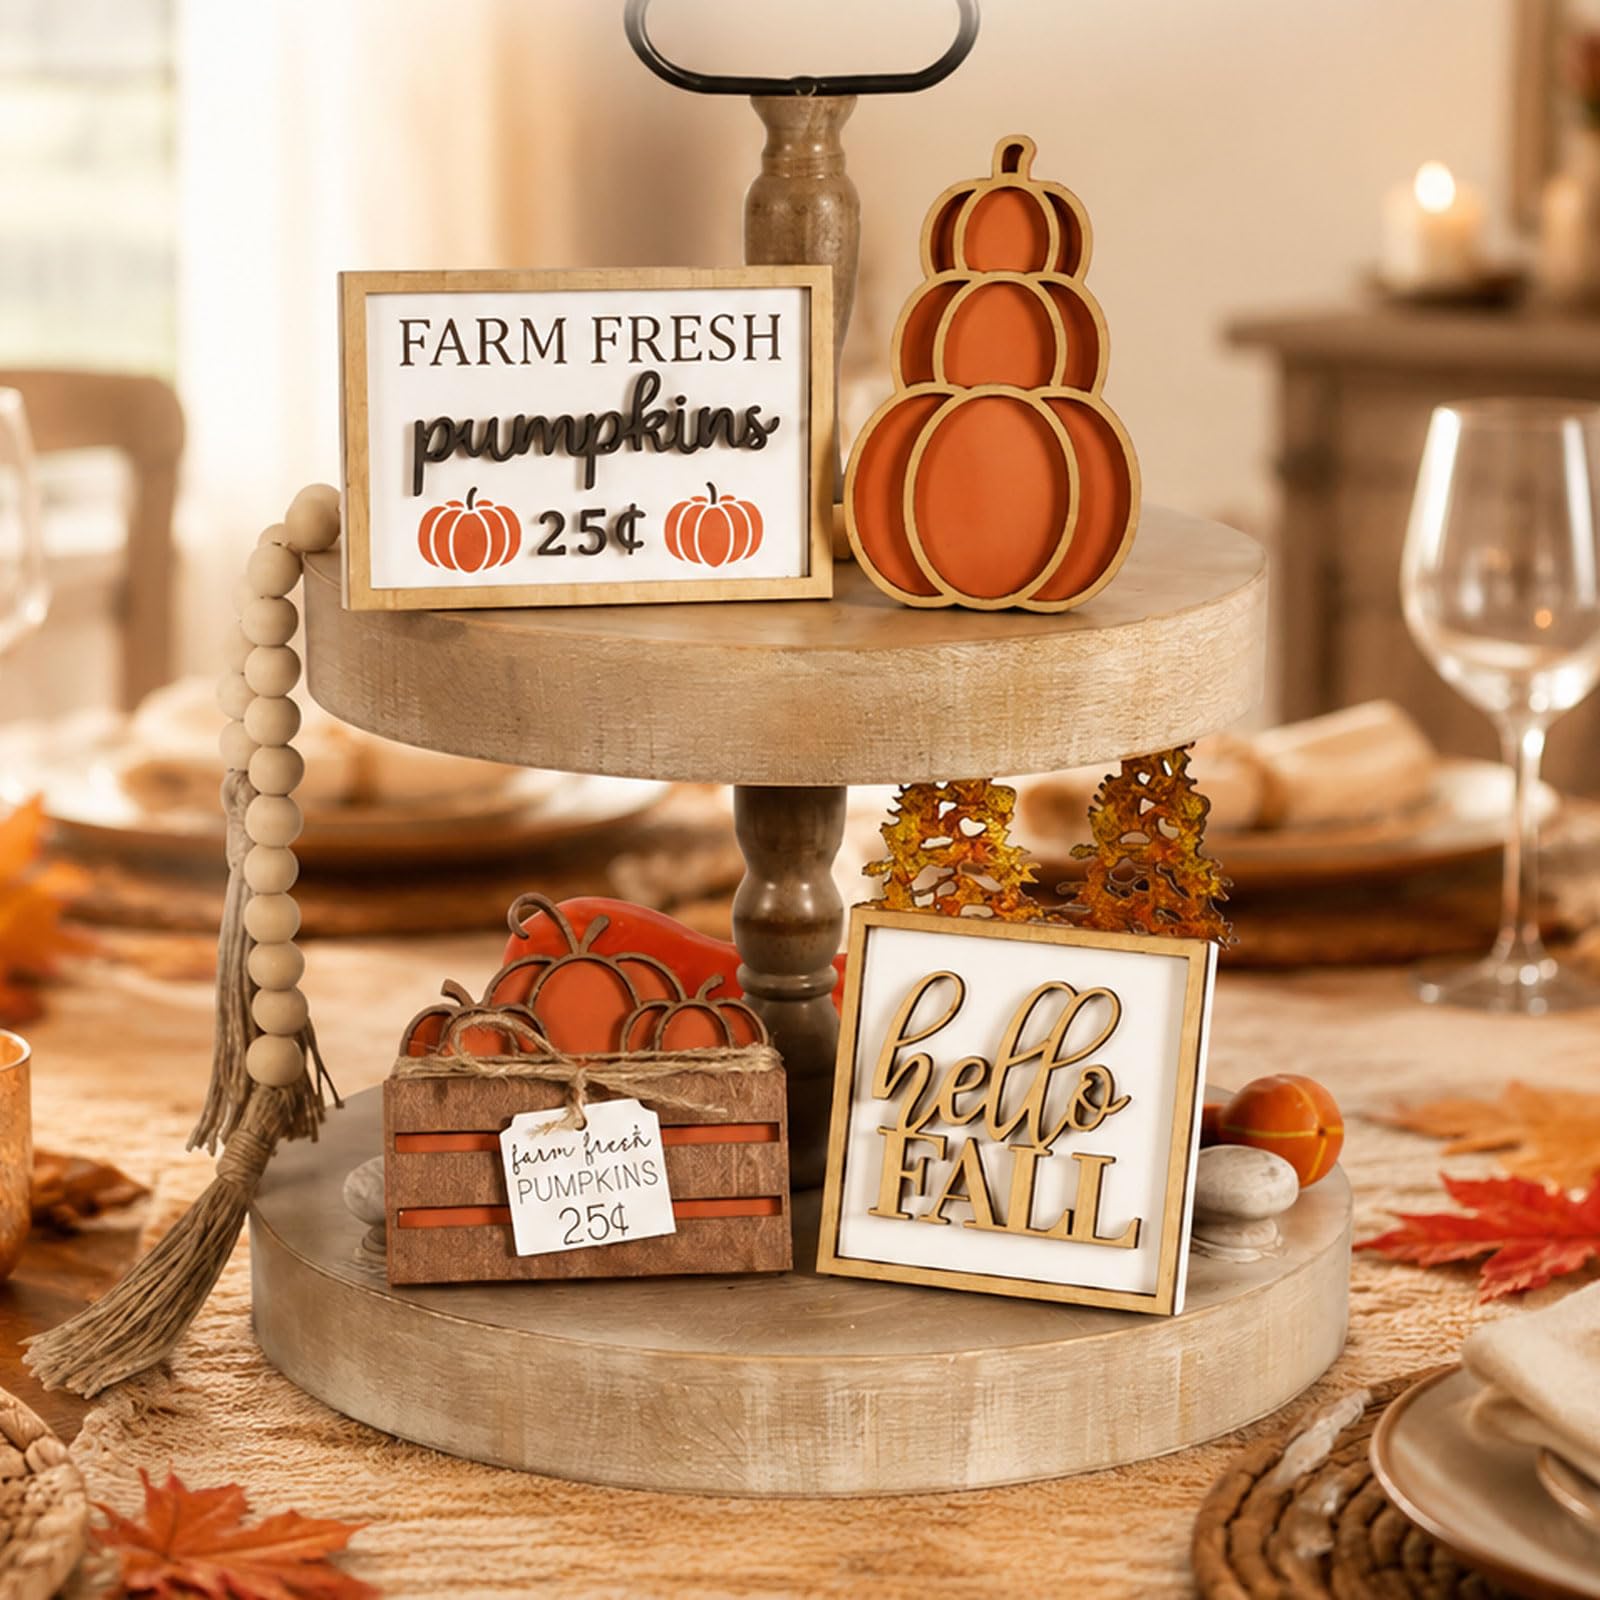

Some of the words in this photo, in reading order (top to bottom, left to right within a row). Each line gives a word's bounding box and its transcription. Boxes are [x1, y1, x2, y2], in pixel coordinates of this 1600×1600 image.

[400, 317, 567, 367] FARM
[591, 313, 782, 364] FRESH
[412, 370, 780, 496] pumpkins
[537, 503, 646, 557] 25¢
[872, 970, 1131, 1149] hello
[512, 1144, 575, 1175] farm
[517, 1160, 659, 1204] PUMPKINS
[868, 1126, 1142, 1249] FALL
[559, 1202, 630, 1246] 25¢
